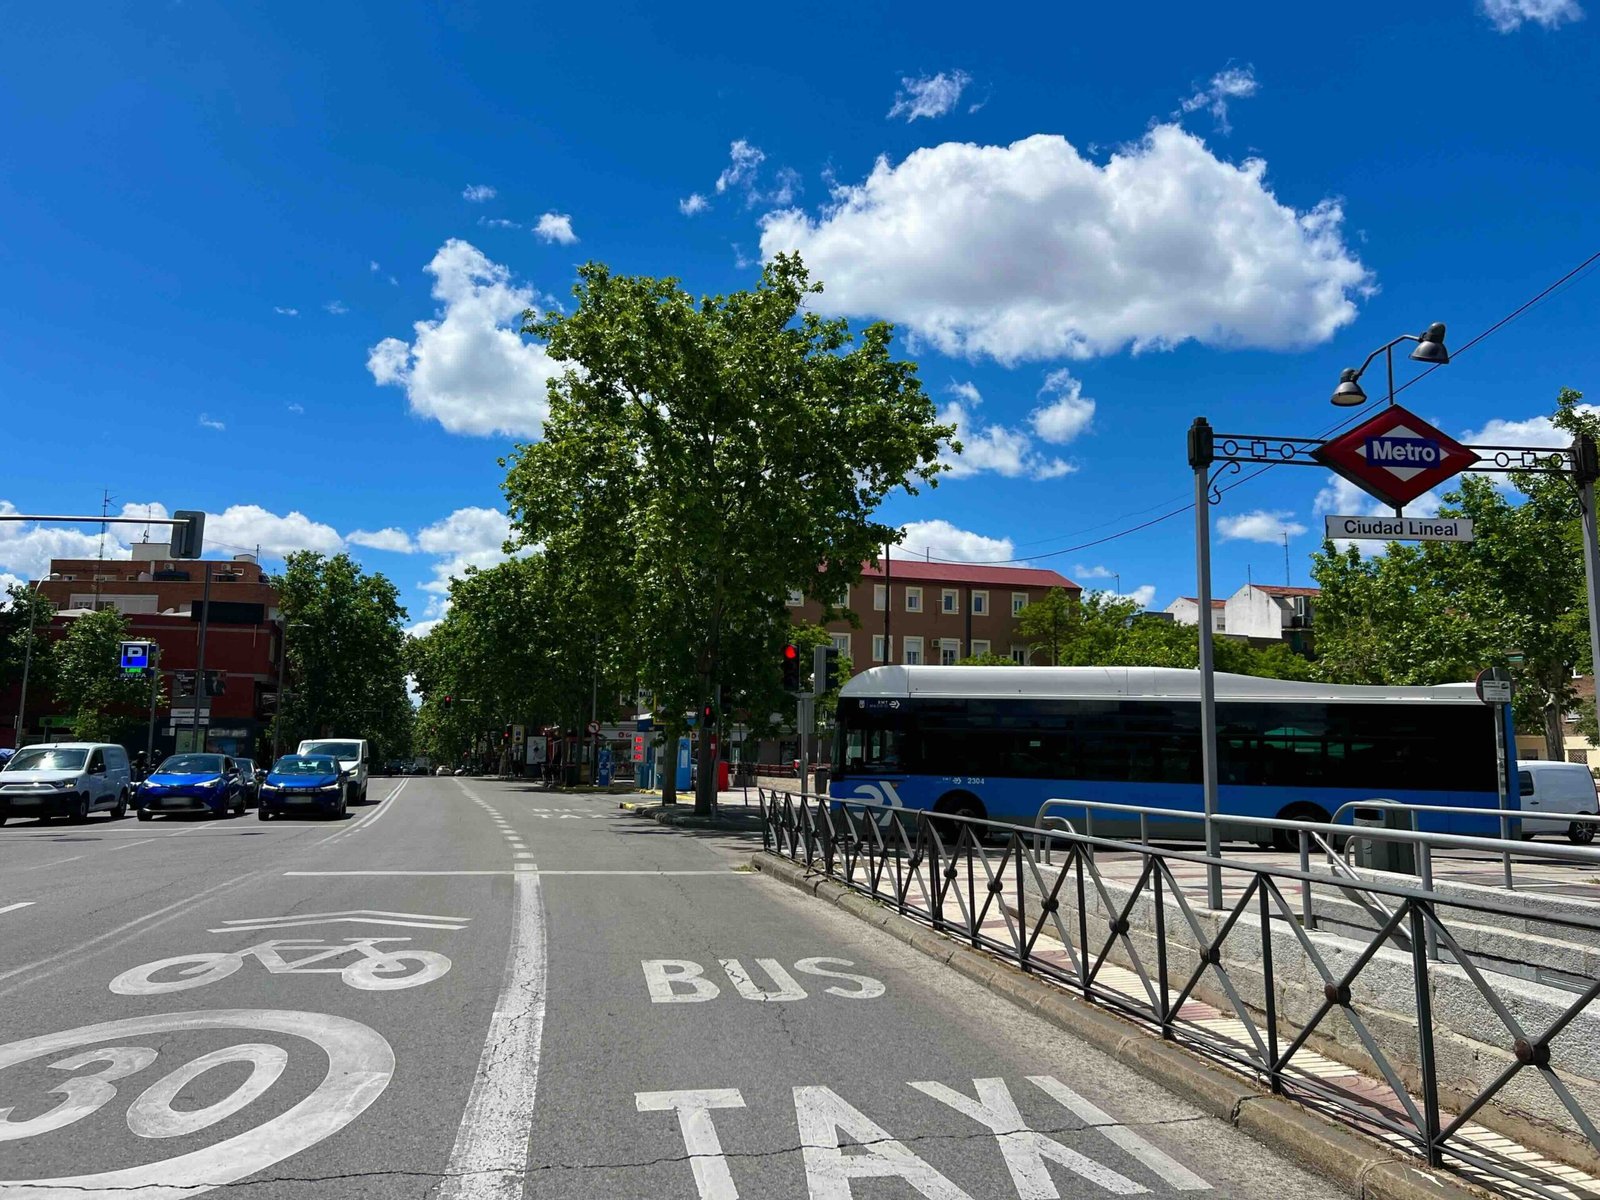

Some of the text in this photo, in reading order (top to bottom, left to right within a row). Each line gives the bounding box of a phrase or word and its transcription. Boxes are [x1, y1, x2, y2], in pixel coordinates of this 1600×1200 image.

[1372, 440, 1436, 463] Metro
[1344, 519, 1458, 536] Ciudad Lineal
[640, 956, 887, 1004] BUS
[0, 1042, 289, 1141] 30
[634, 1075, 1214, 1200] TAXI
